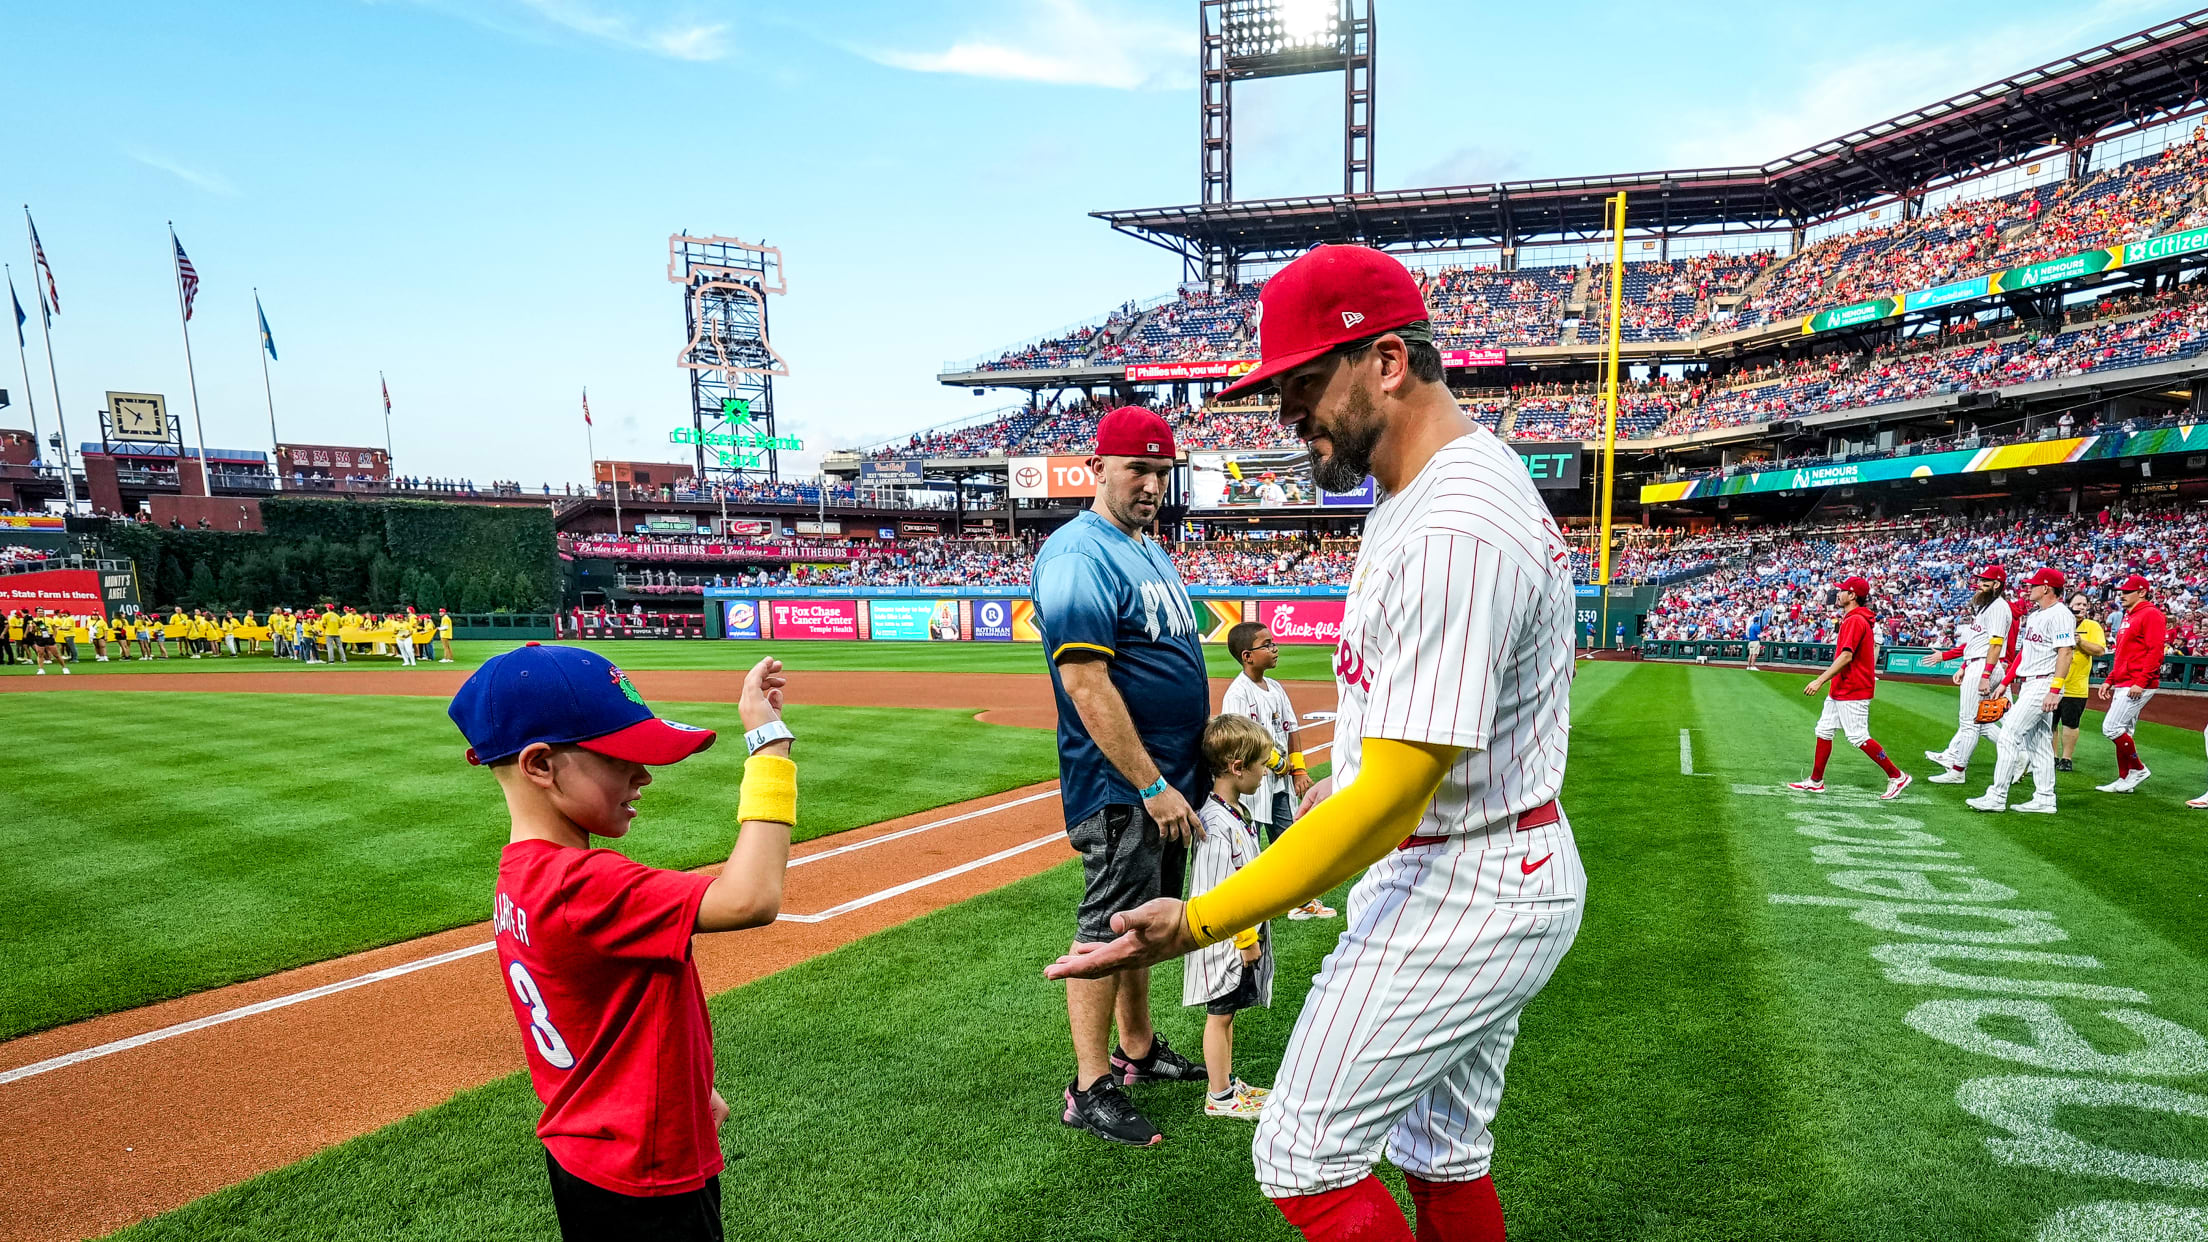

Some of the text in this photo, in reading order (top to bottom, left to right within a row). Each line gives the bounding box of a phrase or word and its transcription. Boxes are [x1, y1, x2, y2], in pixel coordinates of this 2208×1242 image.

[2041, 259, 2085, 275] NEMOURS
[1841, 306, 1876, 319] NEMOURS
[1138, 364, 1227, 377] Phillies win, you win!
[673, 427, 801, 450] Citizens Bank
[293, 450, 307, 461] 32
[313, 451, 329, 463] 34
[335, 452, 350, 463] 36
[358, 453, 372, 465] 42
[719, 450, 760, 468] Park
[1812, 466, 1858, 478] NEMOURS
[576, 542, 628, 553] Budweiser
[637, 544, 706, 555] #HITTHEBUDS
[720, 545, 768, 556] Budweiser
[781, 547, 847, 558] #HITTHEBUDS
[104, 574, 131, 588] MONTY'S
[11, 590, 36, 598] State
[38, 590, 61, 598] Farm
[62, 591, 71, 599] is
[72, 591, 98, 600] there.
[108, 587, 127, 600] ANGLE
[791, 606, 841, 616] Fox Chase
[988, 609, 998, 619] R
[1578, 610, 1597, 623] 330
[792, 616, 853, 625] Cancer Center
[809, 625, 832, 634] Temple
[509, 960, 577, 1070] 3
[1768, 810, 2208, 1242] pendence
